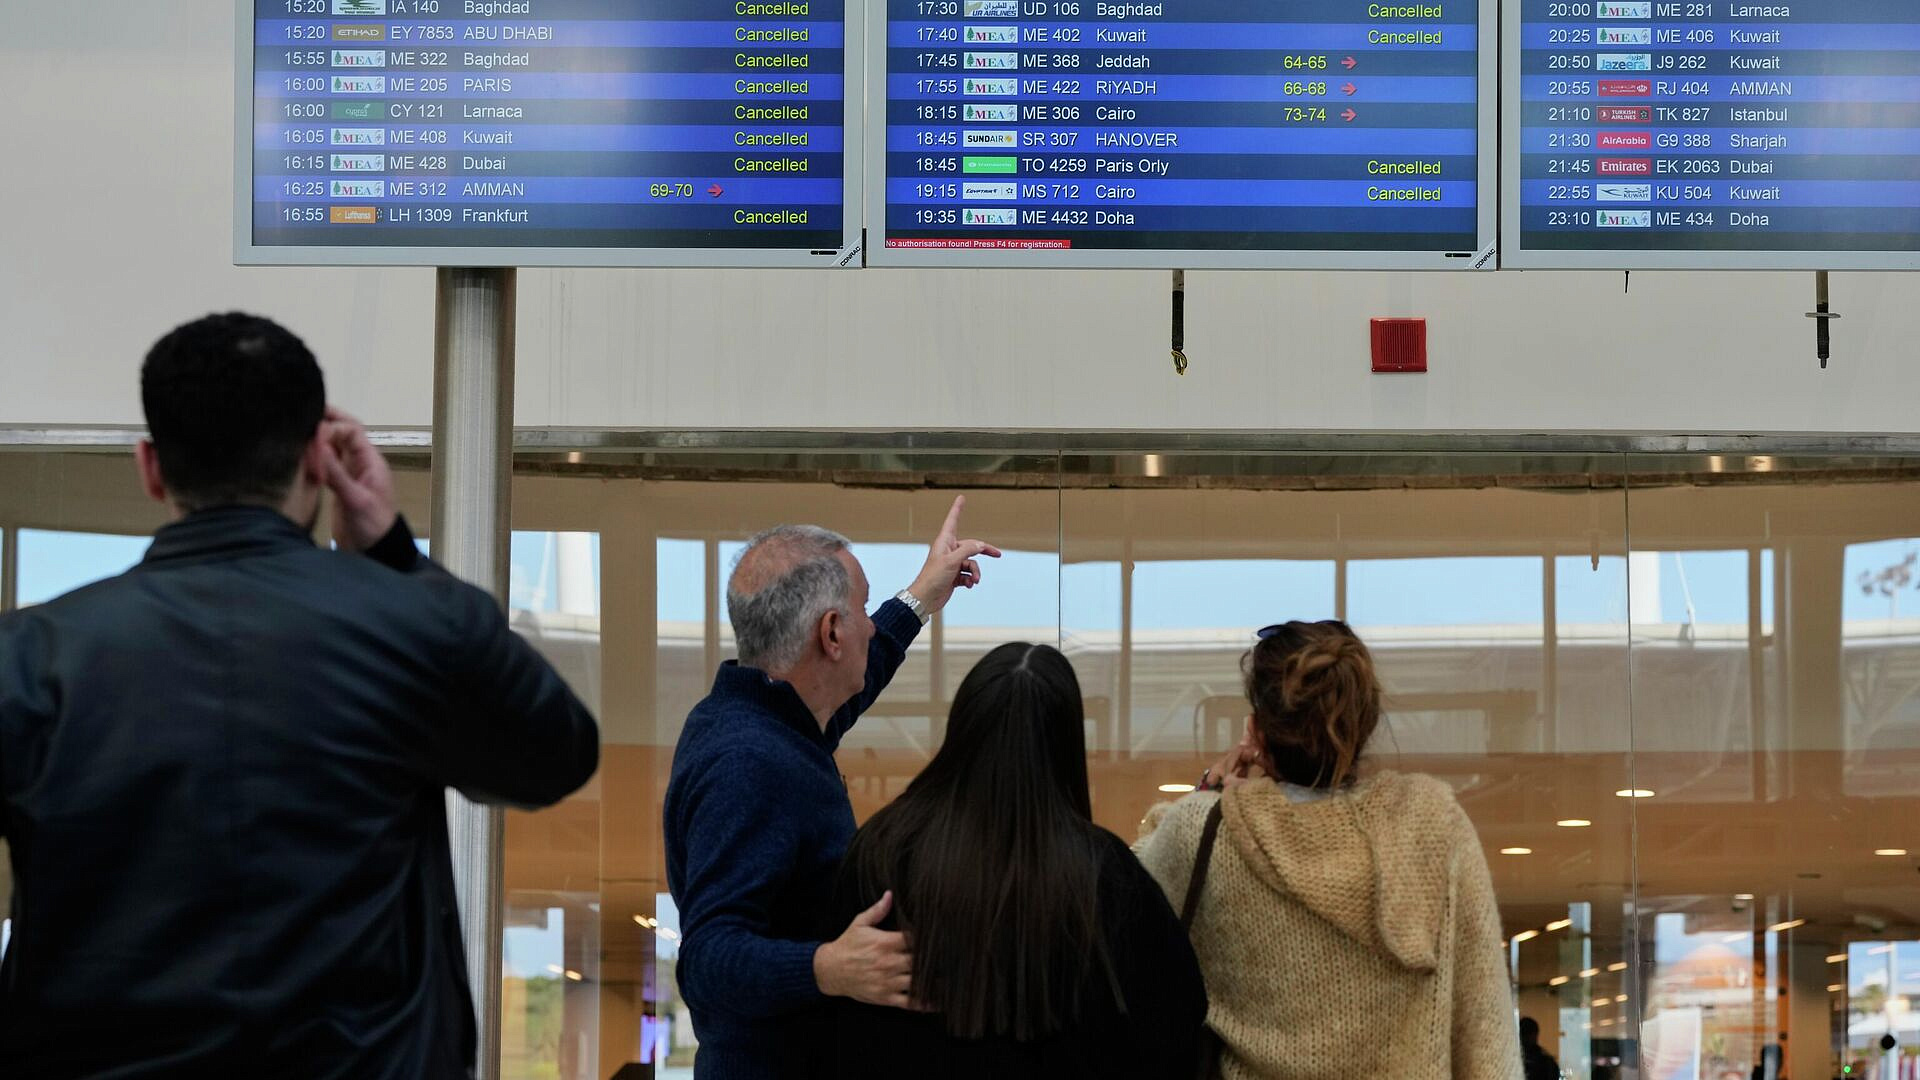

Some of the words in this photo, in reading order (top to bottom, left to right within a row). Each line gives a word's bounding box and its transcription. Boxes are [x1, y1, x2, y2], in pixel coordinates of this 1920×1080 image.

[286, 0, 325, 12] 15:20
[392, 0, 406, 13] IA
[413, 1, 438, 13] 140
[465, 1, 529, 16] Baghdad
[736, 2, 808, 14] Cancelled
[918, 2, 957, 14] 17:30
[1024, 2, 1046, 15] UD
[1054, 2, 1079, 15] 106
[1097, 3, 1161, 18] Baghdad
[1369, 4, 1441, 17] Cancelled
[1549, 4, 1590, 16] 20:00
[1657, 4, 1680, 16] ME
[1687, 4, 1711, 16] 281
[1731, 4, 1789, 16] Larnaca
[1608, 8, 1638, 16] MEA
[285, 26, 324, 38] 15:20
[392, 26, 412, 38] EY
[418, 26, 453, 39] 7853
[464, 27, 497, 39] ABU
[504, 27, 552, 39] DHABI
[736, 28, 808, 40] Cancelled
[918, 28, 957, 40] 17:40
[1024, 29, 1047, 41] ME
[1053, 29, 1079, 41] 402
[1097, 29, 1146, 41] Kuwait
[1369, 30, 1441, 43] Cancelled
[975, 32, 1005, 41] MEA
[1549, 30, 1590, 42] 20:25
[1657, 30, 1681, 42] ME
[1686, 30, 1713, 42] 406
[1731, 30, 1779, 42] Kuwait
[1608, 34, 1638, 42] MEA
[285, 52, 324, 64] 15:55
[392, 52, 414, 65] ME
[421, 53, 447, 65] 322
[465, 53, 528, 68] Baghdad
[735, 54, 807, 67] Cancelled
[343, 56, 372, 65] MEA
[917, 54, 957, 66] 17:45
[1024, 55, 1047, 67] ME
[1053, 55, 1079, 67] 368
[1097, 55, 1149, 68] Jeddah
[1285, 56, 1326, 68] 64-65
[975, 58, 1005, 67] MEA
[1549, 56, 1590, 68] 20:50
[1657, 56, 1673, 68] J9
[1679, 56, 1706, 68] 262
[1731, 56, 1780, 68] Kuwait
[285, 78, 324, 90] 16:00
[391, 78, 414, 91] ME
[420, 79, 447, 91] 205
[464, 79, 511, 91] PARIS
[735, 80, 807, 93] Cancelled
[343, 82, 372, 91] MEA
[917, 80, 956, 92] 17:55
[1024, 81, 1047, 93] ME
[1052, 81, 1079, 93] 422
[1097, 81, 1155, 94] RiYADH
[1284, 82, 1325, 94] 66-68
[975, 84, 1005, 93] MEA
[1549, 82, 1590, 94] 20:55
[1657, 82, 1677, 94] RJ
[1681, 82, 1709, 94] 404
[1730, 82, 1791, 95] AMMAN
[285, 104, 324, 116] 16:00
[391, 104, 413, 117] CY
[419, 104, 442, 117] 121
[464, 105, 522, 117] Larnaca
[735, 106, 807, 119] Cancelled
[917, 106, 956, 119] 18:15
[1024, 107, 1047, 119] ME
[1053, 107, 1079, 119] 306
[1097, 107, 1135, 120] Cairo
[1284, 108, 1326, 121] 73-74
[975, 110, 1005, 119] MEA
[1549, 108, 1590, 120] 21:10
[1656, 108, 1677, 120] TK
[1683, 108, 1709, 120] 827
[1731, 108, 1787, 121] Istanbul
[284, 130, 323, 142] 16:05
[391, 131, 414, 143] ME
[420, 130, 446, 143] 408
[464, 131, 512, 143] Kuwait
[735, 132, 807, 145] Cancelled
[917, 132, 956, 144] 18:45
[1023, 132, 1045, 145] SR
[1051, 133, 1077, 145] 307
[1097, 133, 1177, 146] HANOVER
[1549, 134, 1589, 146] 21:30
[1657, 134, 1678, 146] G9
[1684, 134, 1710, 146] 388
[1731, 134, 1786, 150] Sharjah
[284, 156, 323, 168] 16:15
[391, 157, 414, 169] ME
[419, 157, 446, 169] 428
[464, 157, 505, 169] Dubai
[735, 158, 807, 171] Cancelled
[917, 158, 956, 171] 18:45
[1022, 159, 1044, 171] TO
[1050, 159, 1086, 171] 4259
[1096, 159, 1133, 172] Paris
[1139, 159, 1169, 175] Orly
[1368, 161, 1440, 174] Cancelled
[1549, 160, 1589, 172] 21:45
[1657, 160, 1678, 173] EK
[1684, 160, 1720, 173] 2063
[1731, 160, 1772, 173] Dubai
[1601, 161, 1647, 172] Emirates
[284, 182, 323, 194] 16:25
[391, 183, 413, 195] ME
[420, 183, 446, 195] 312
[463, 183, 523, 195] AMMAN
[651, 184, 692, 196] 69-70
[342, 186, 372, 195] MEA
[916, 184, 956, 197] 19:15
[1023, 185, 1046, 197] MS
[1052, 185, 1078, 197] 712
[1096, 185, 1134, 198] Cairo
[1368, 187, 1440, 200] Cancelled
[1549, 186, 1589, 198] 22:55
[1657, 186, 1678, 199] KU
[1685, 186, 1711, 199] 504
[1731, 186, 1779, 199] Kuwait
[284, 208, 323, 221] 16:55
[390, 209, 409, 221] LH
[417, 209, 451, 221] 1309
[463, 209, 528, 222] Frankfurt
[735, 210, 807, 223] Cancelled
[916, 210, 955, 223] 19:35
[1023, 211, 1046, 223] ME
[1051, 211, 1088, 224] 4432
[1096, 211, 1134, 224] Doha
[974, 214, 1004, 223] MEA
[1549, 212, 1589, 224] 23:10
[1657, 212, 1680, 225] ME
[1686, 213, 1713, 225] 434
[1731, 213, 1768, 225] Doha
[1608, 216, 1638, 225] MEA
